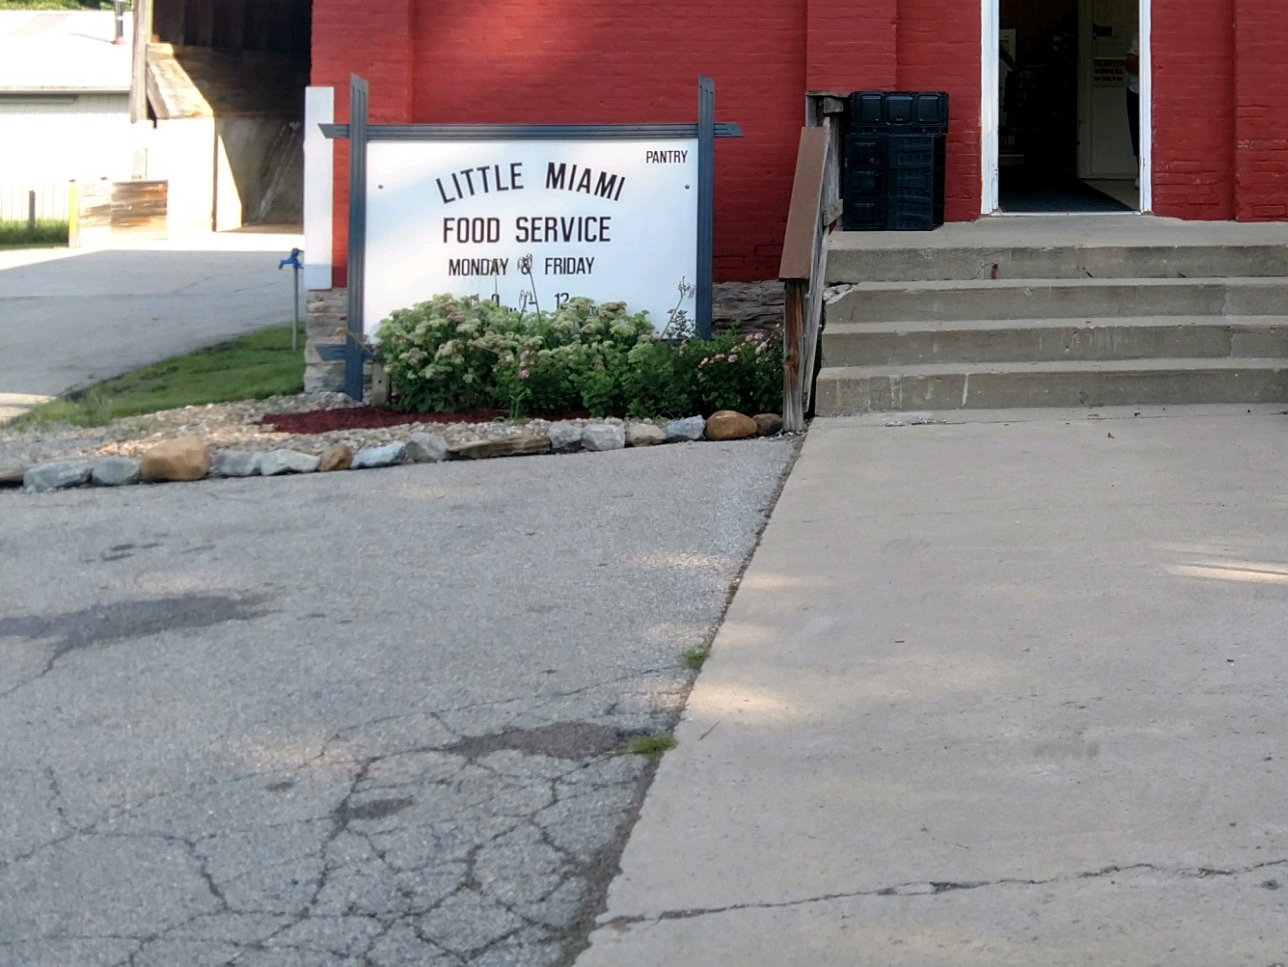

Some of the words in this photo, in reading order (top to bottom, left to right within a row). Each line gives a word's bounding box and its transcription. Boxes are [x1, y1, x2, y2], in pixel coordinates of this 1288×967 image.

[645, 150, 688, 164] PANTRY
[436, 162, 524, 204] LITTLE
[545, 162, 626, 202] MIAMI
[443, 217, 501, 244] FOOD
[515, 216, 612, 243] SERVICE
[448, 258, 509, 276] MONDAY
[544, 257, 595, 276] FRIDAY
